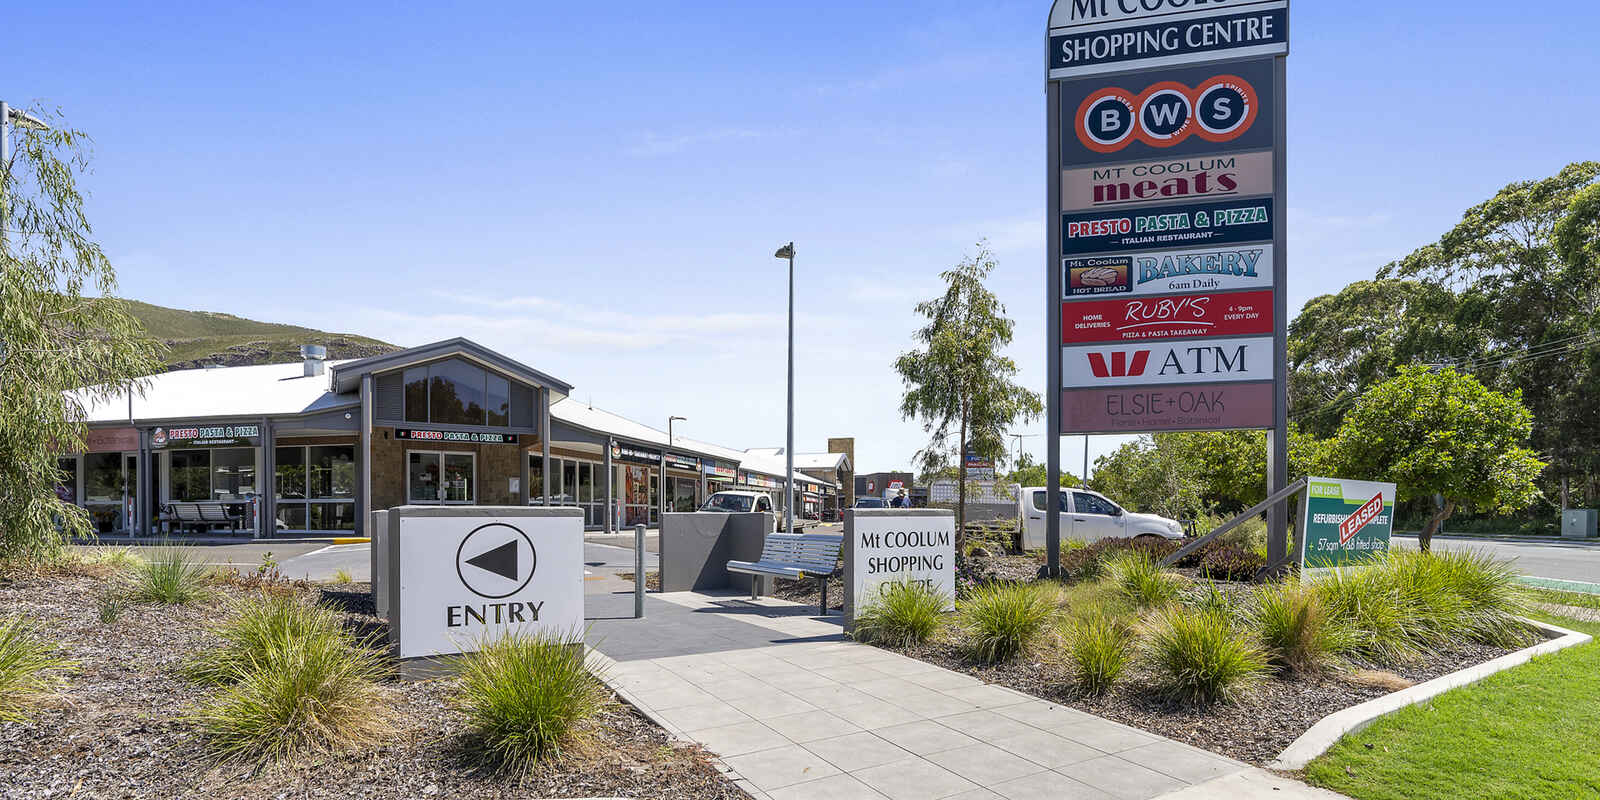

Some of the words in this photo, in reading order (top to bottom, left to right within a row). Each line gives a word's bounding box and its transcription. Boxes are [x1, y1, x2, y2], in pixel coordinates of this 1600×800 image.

[1062, 27, 1179, 62] SHOPPING
[1185, 15, 1273, 48] CENTRE
[1093, 168, 1125, 180] MT
[1132, 157, 1235, 176] COOLUM
[1093, 171, 1238, 202] meats
[1068, 217, 1131, 238] PRESTO
[1135, 212, 1190, 233] PASTA
[1194, 210, 1209, 228] &
[1213, 206, 1269, 226] PIZZA
[1121, 235, 1155, 245] ITALIAN
[1156, 231, 1214, 242] RESTAURANT
[1087, 258, 1129, 267] Coolum
[1137, 249, 1263, 285] BAKERY
[1093, 285, 1127, 293] BREAD
[1168, 280, 1191, 290] 6am
[1193, 278, 1220, 290] Daily
[1125, 297, 1210, 321] RUBY'S
[1224, 313, 1244, 321] EVERY
[1170, 328, 1208, 337] TAKEAWAY
[1158, 345, 1249, 376] ATM
[169, 428, 198, 439] PRESTO
[199, 427, 225, 438] PASTA
[225, 426, 234, 437] &
[234, 426, 259, 437] PIZZA
[411, 430, 443, 439] PRESTO
[443, 431, 470, 441] PASTA
[470, 432, 479, 441] &
[479, 433, 504, 442] PIZZA
[1341, 498, 1381, 538] LEASED
[861, 532, 881, 549] Mt
[884, 531, 950, 548] COOLUM
[868, 554, 943, 574] SHOPPING
[447, 601, 544, 627] ENTRY
